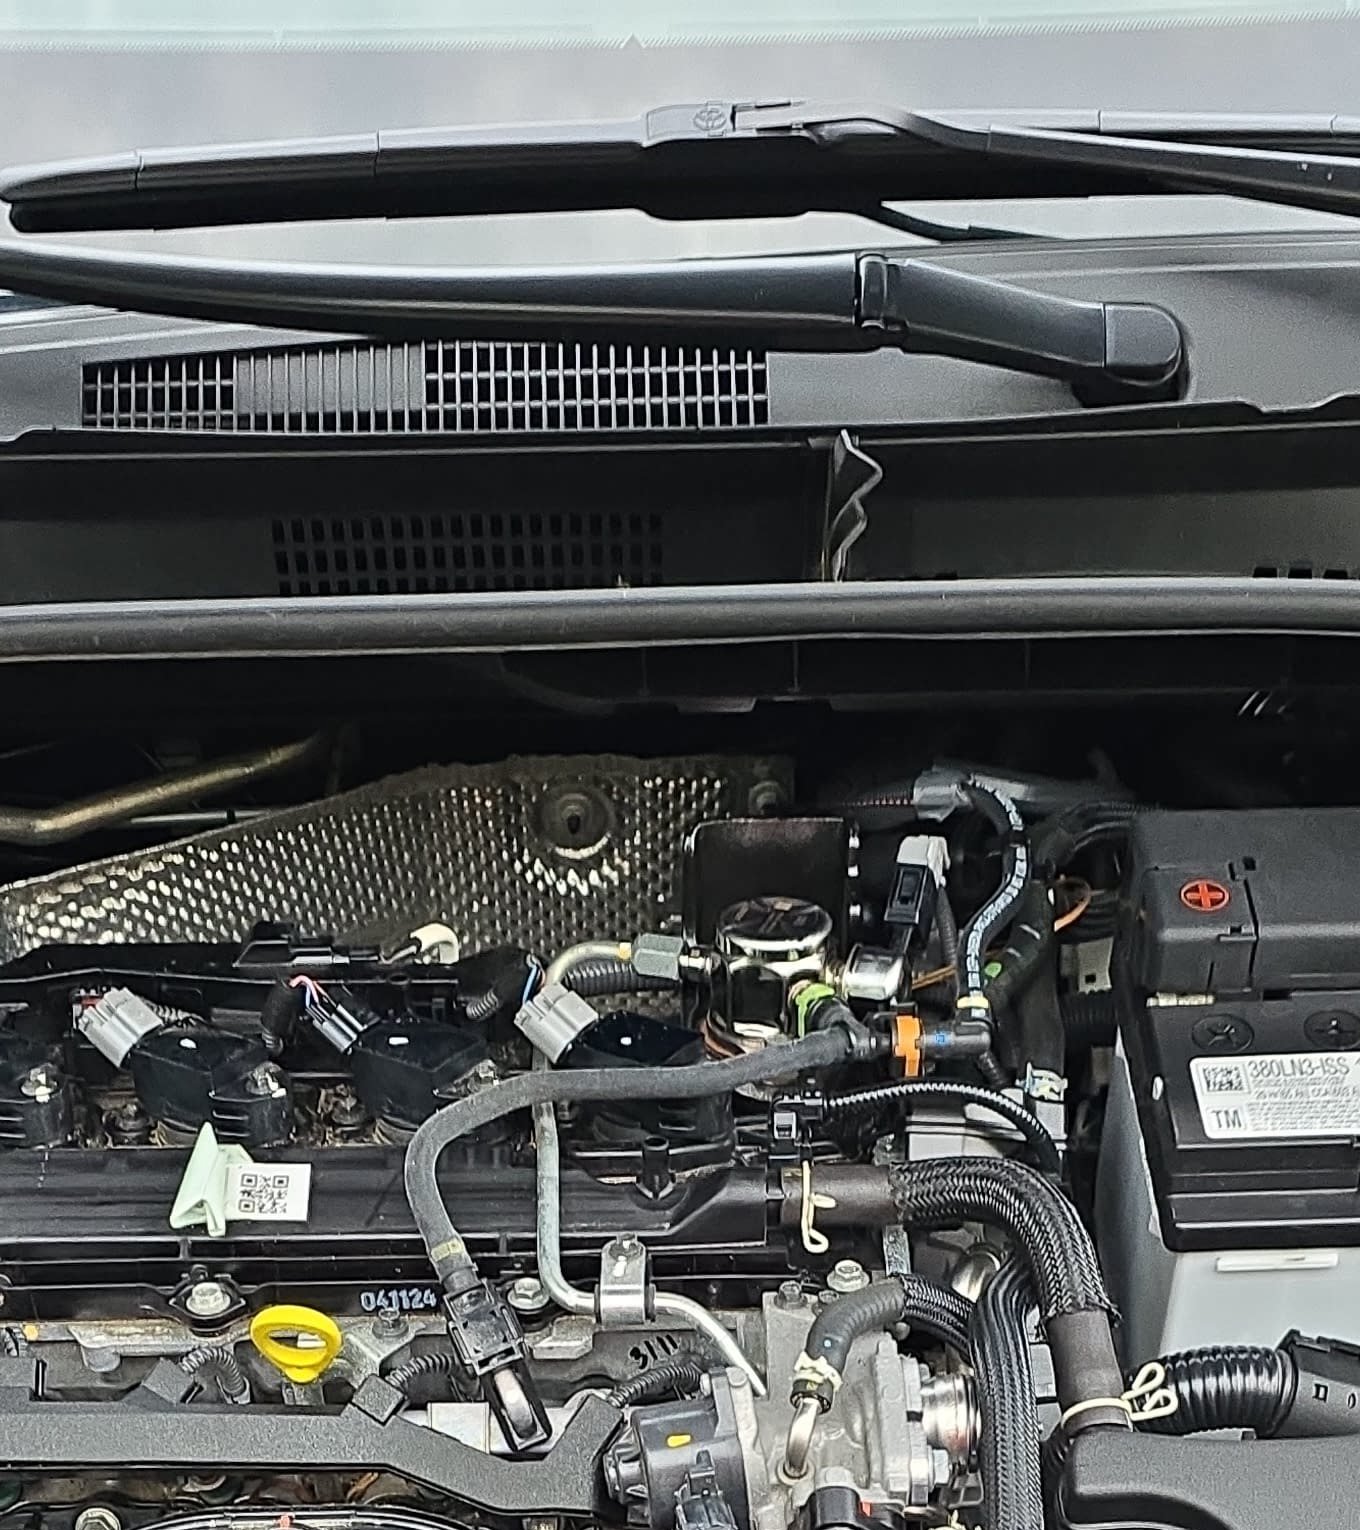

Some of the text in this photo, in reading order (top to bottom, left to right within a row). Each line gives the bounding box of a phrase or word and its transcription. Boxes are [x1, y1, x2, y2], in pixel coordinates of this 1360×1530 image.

[1248, 1057, 1350, 1079] 380LN3-ISS
[1211, 1108, 1242, 1129] TM
[360, 1288, 437, 1312] 041124
